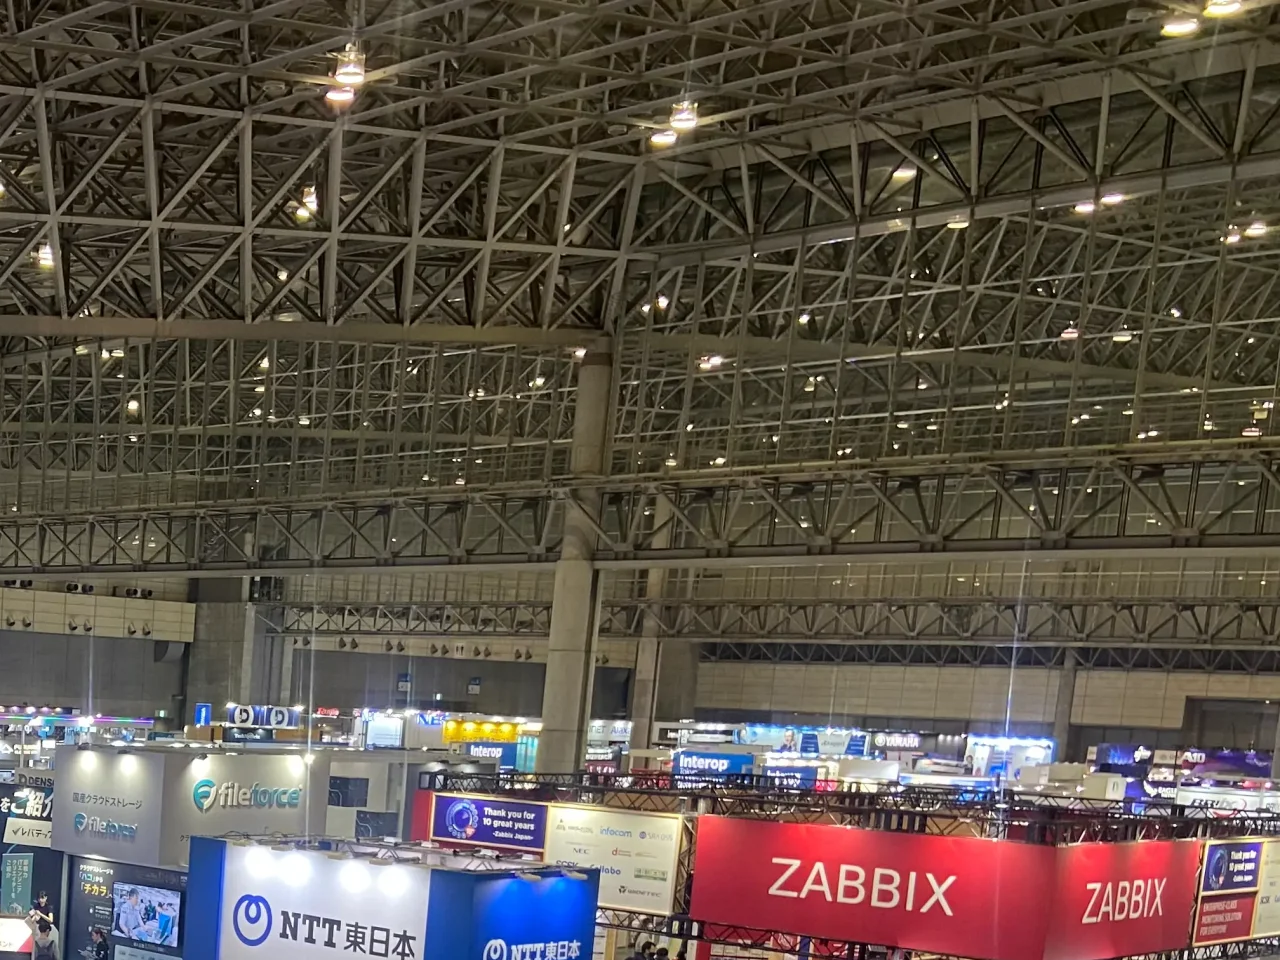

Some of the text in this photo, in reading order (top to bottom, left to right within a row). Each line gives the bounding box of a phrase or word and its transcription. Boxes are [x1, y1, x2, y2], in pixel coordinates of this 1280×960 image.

[886, 738, 919, 749] YAMAHA
[470, 744, 503, 758] Interop
[1182, 752, 1206, 763] A10
[680, 755, 728, 772] Interop
[29, 777, 54, 787] DENS
[72, 792, 143, 810] 国産クラウドストレージ
[219, 783, 302, 809] fileforce
[484, 806, 536, 821] Thank you for
[483, 818, 535, 831] 10 great years
[600, 826, 633, 838] infocom
[768, 857, 957, 917] ZABBIX
[1081, 877, 1167, 925] ZABBIX
